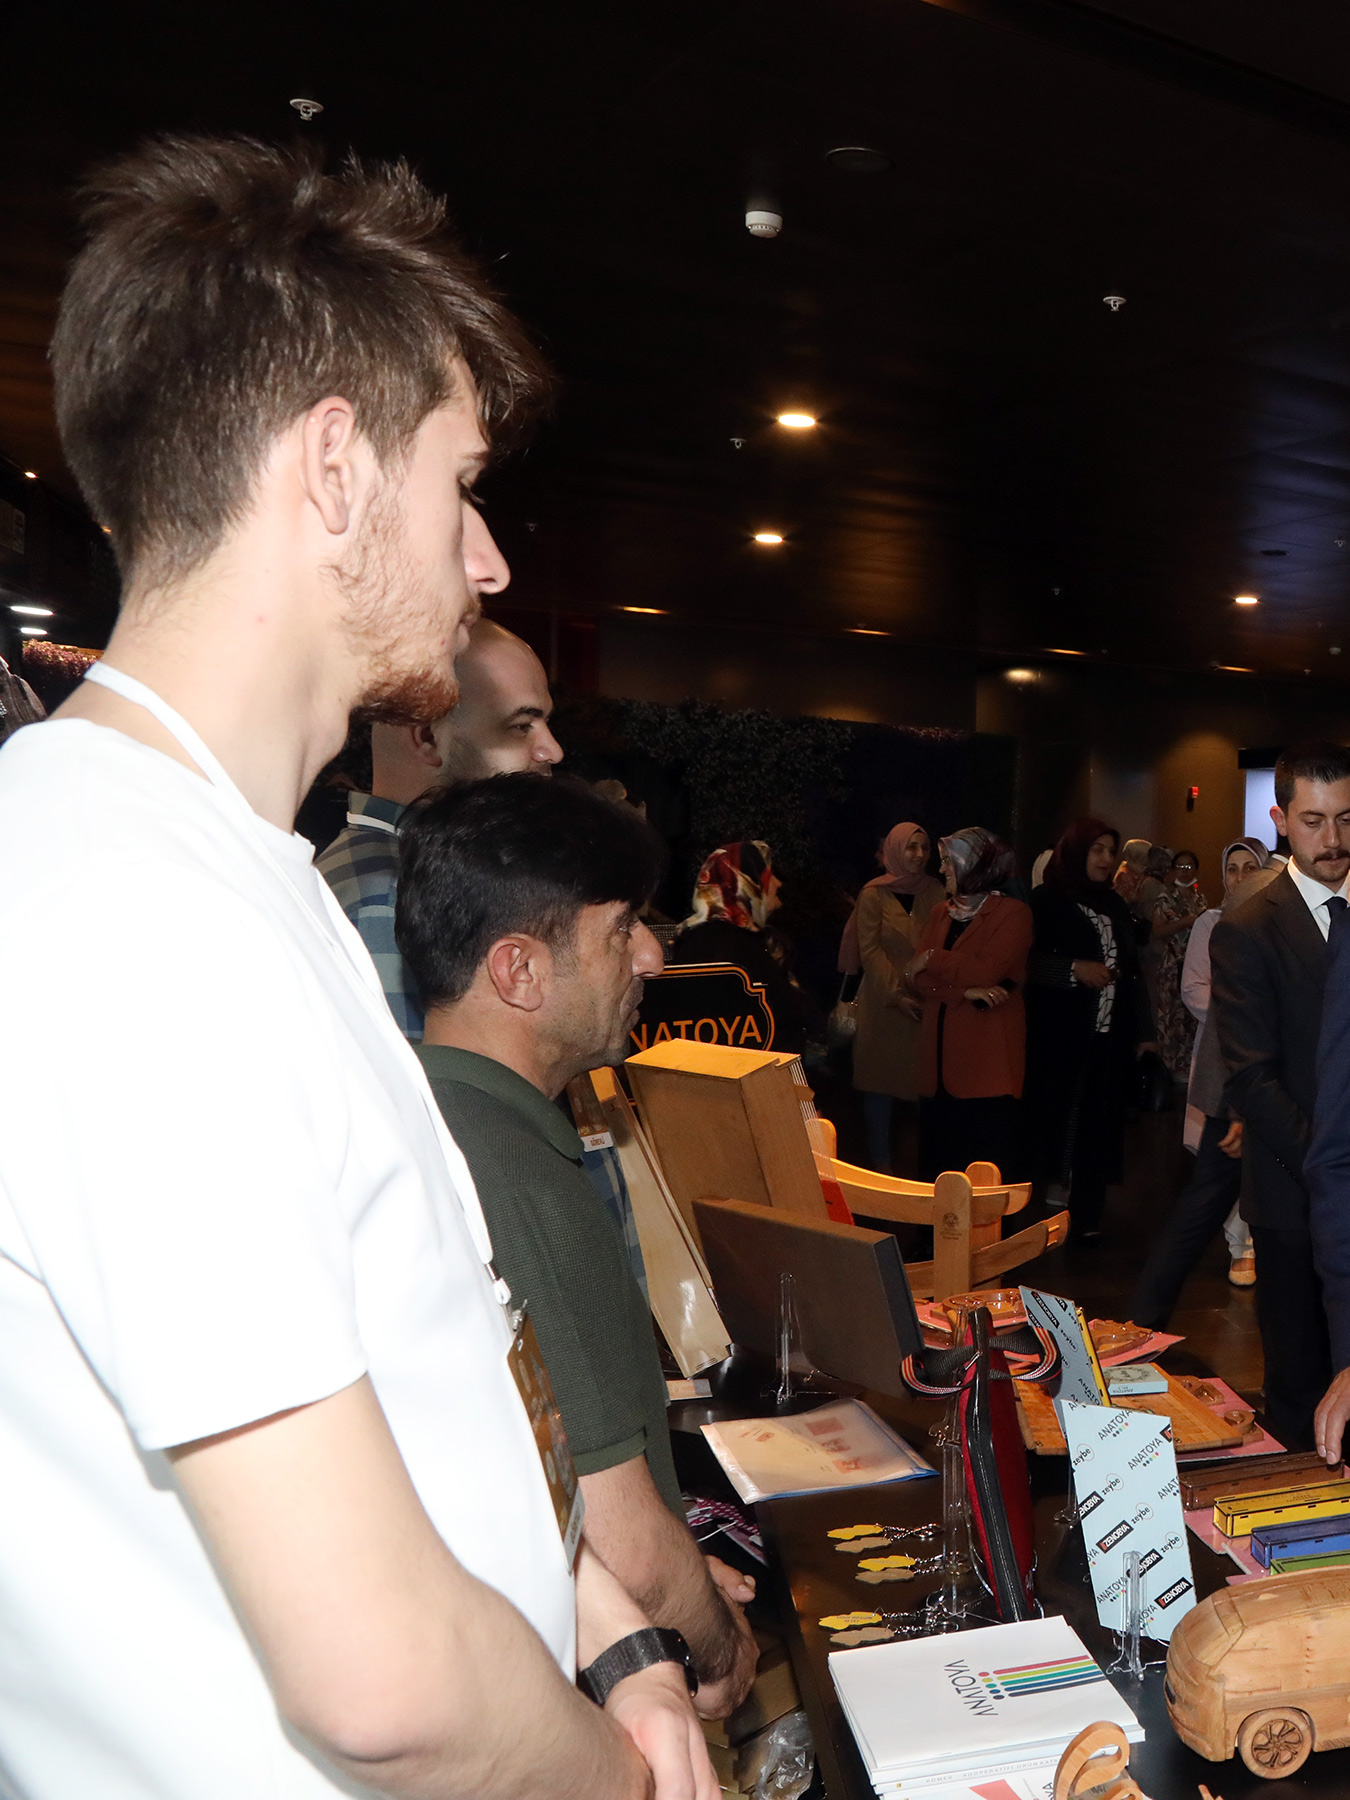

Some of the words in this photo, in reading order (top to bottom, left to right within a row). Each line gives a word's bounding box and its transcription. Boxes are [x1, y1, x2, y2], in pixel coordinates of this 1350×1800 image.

[630, 1014, 763, 1050] NATOYA
[1098, 1409, 1132, 1441] ANATOYA
[1072, 1448, 1092, 1467] zeybe
[1127, 1438, 1163, 1470] ANATOYA
[1101, 1477, 1121, 1496] zeybe
[1131, 1506, 1151, 1525] zeybe
[1103, 1523, 1131, 1548] ZENOBYA
[1160, 1535, 1180, 1554] zeybe
[1162, 1580, 1190, 1605] ZENOBYA
